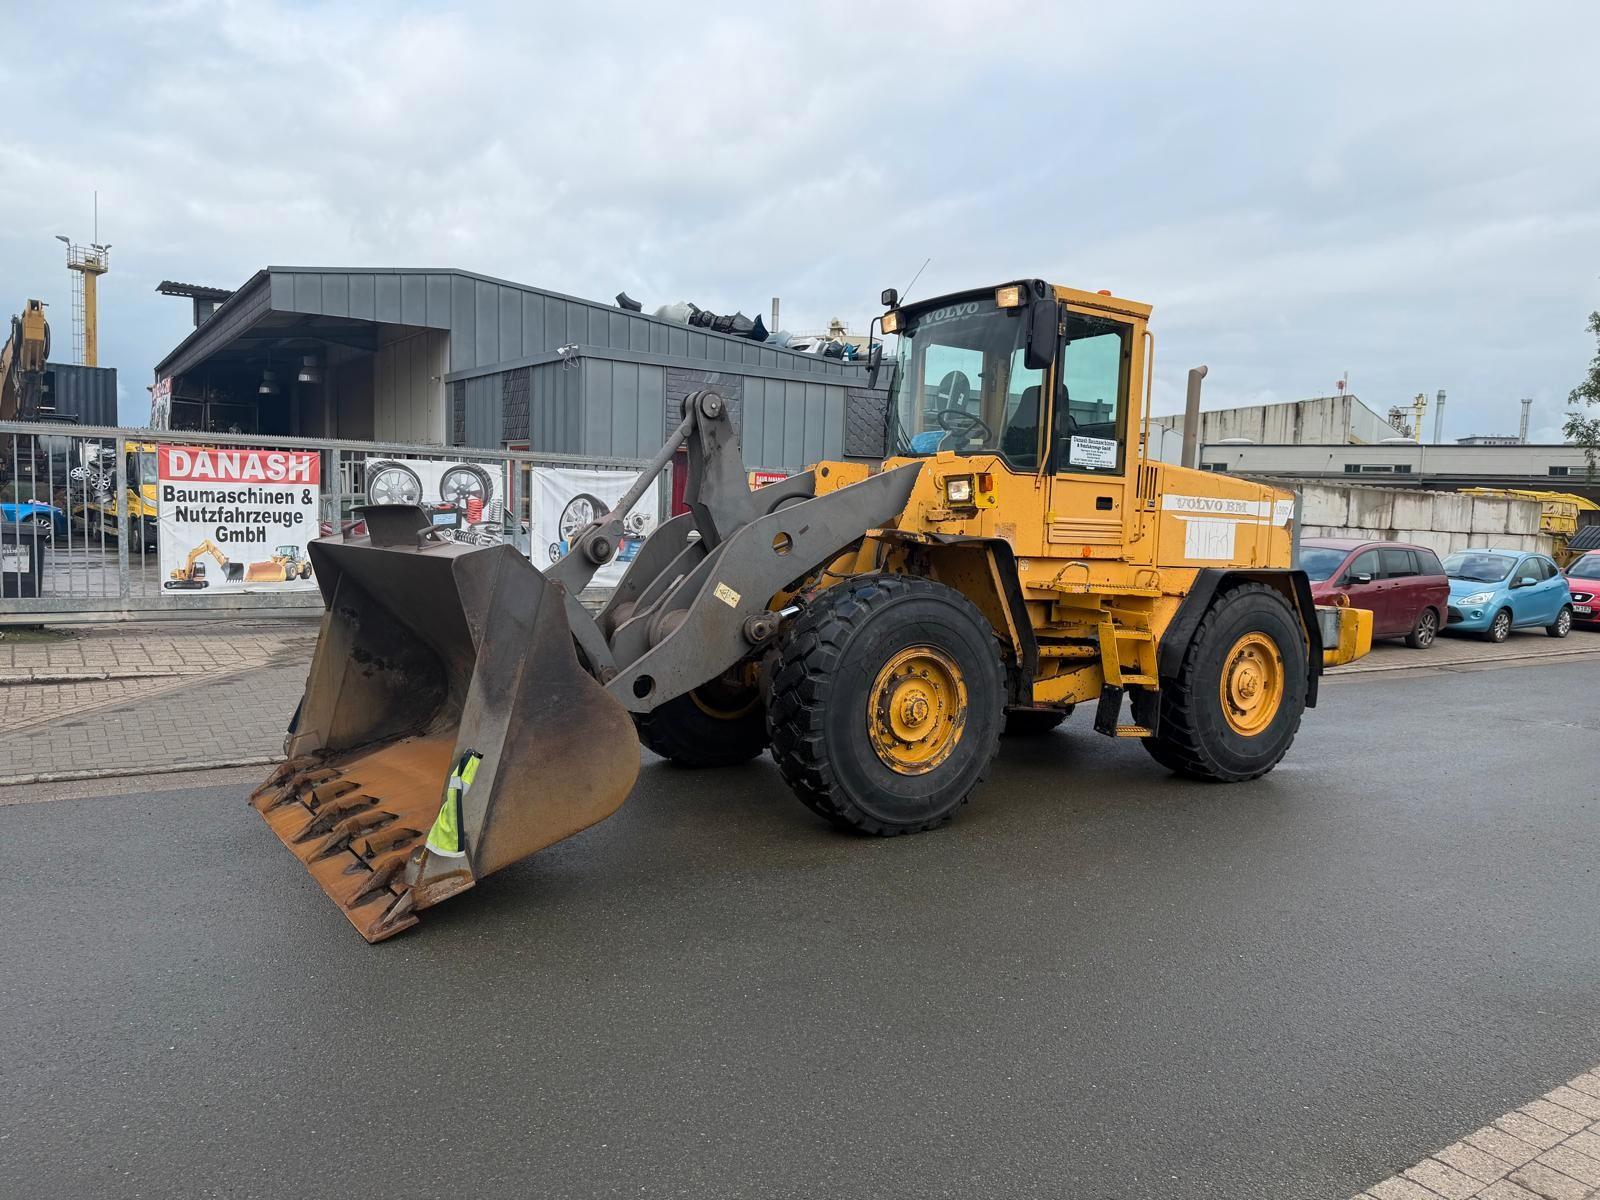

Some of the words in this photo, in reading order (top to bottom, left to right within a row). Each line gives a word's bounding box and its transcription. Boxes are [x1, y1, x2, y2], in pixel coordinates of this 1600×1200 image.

[926, 302, 979, 324] VOLVO
[169, 450, 310, 481] DANASH
[163, 485, 295, 504] Baumaschinen
[301, 488, 313, 505] &
[1176, 498, 1223, 511] VOLVO
[1226, 502, 1248, 513] BM
[175, 505, 304, 528] Nutzfahrzeuge
[215, 525, 266, 543] GmbH
